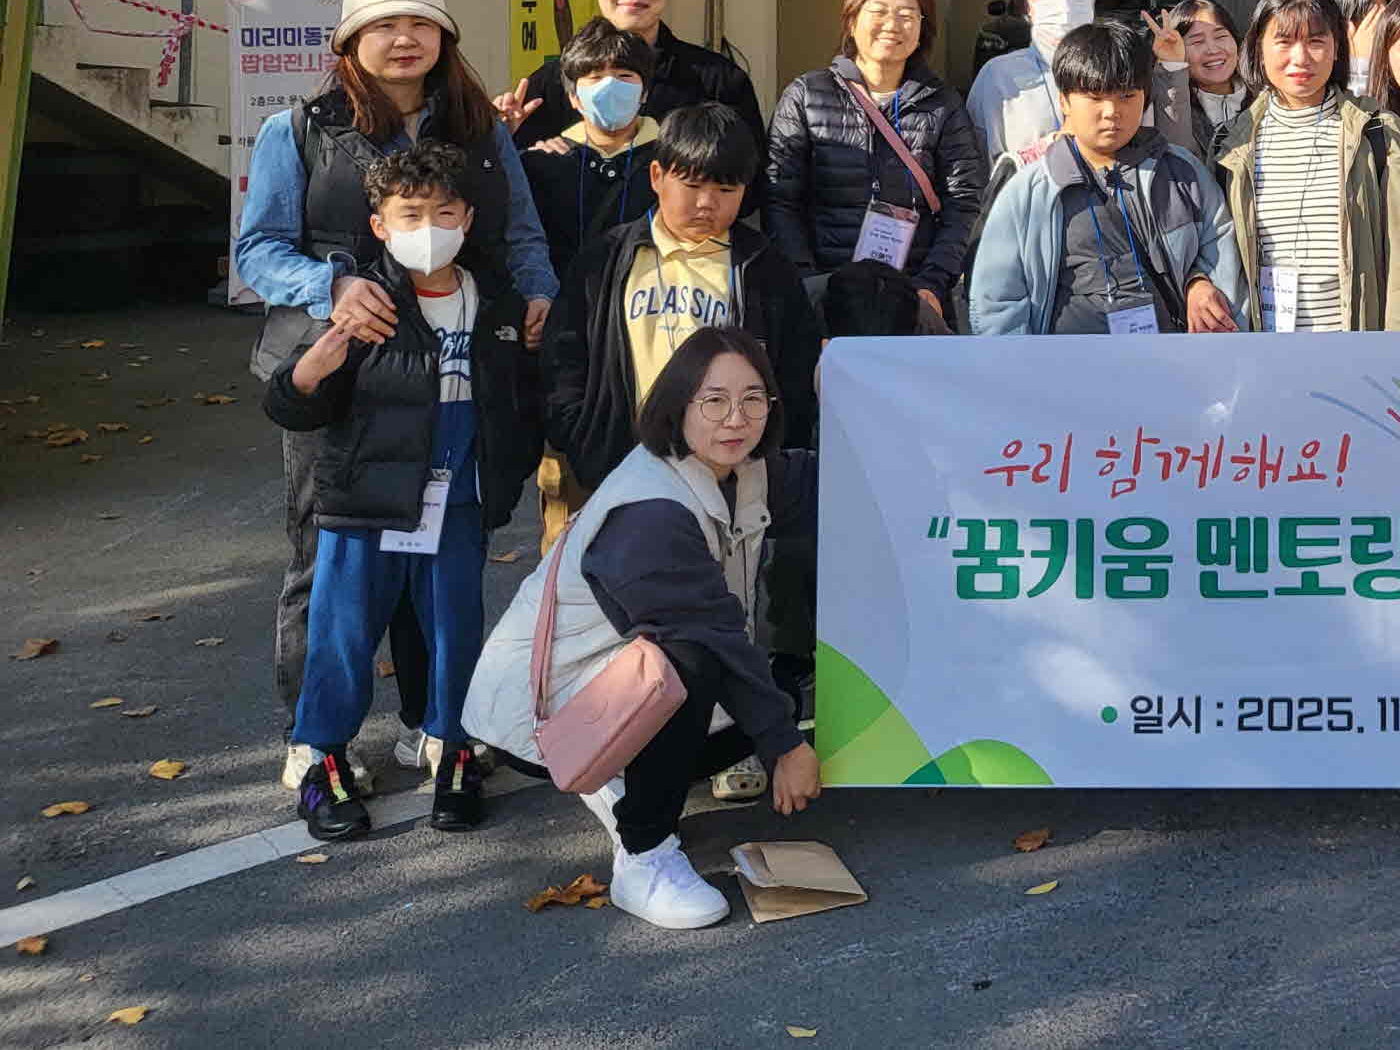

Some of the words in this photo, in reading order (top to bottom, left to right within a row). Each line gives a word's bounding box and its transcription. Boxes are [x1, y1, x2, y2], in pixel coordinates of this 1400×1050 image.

[984, 432, 1072, 491] 우리
[1096, 427, 1351, 498] 함께해요!
[1237, 697, 1365, 735] 2025.
